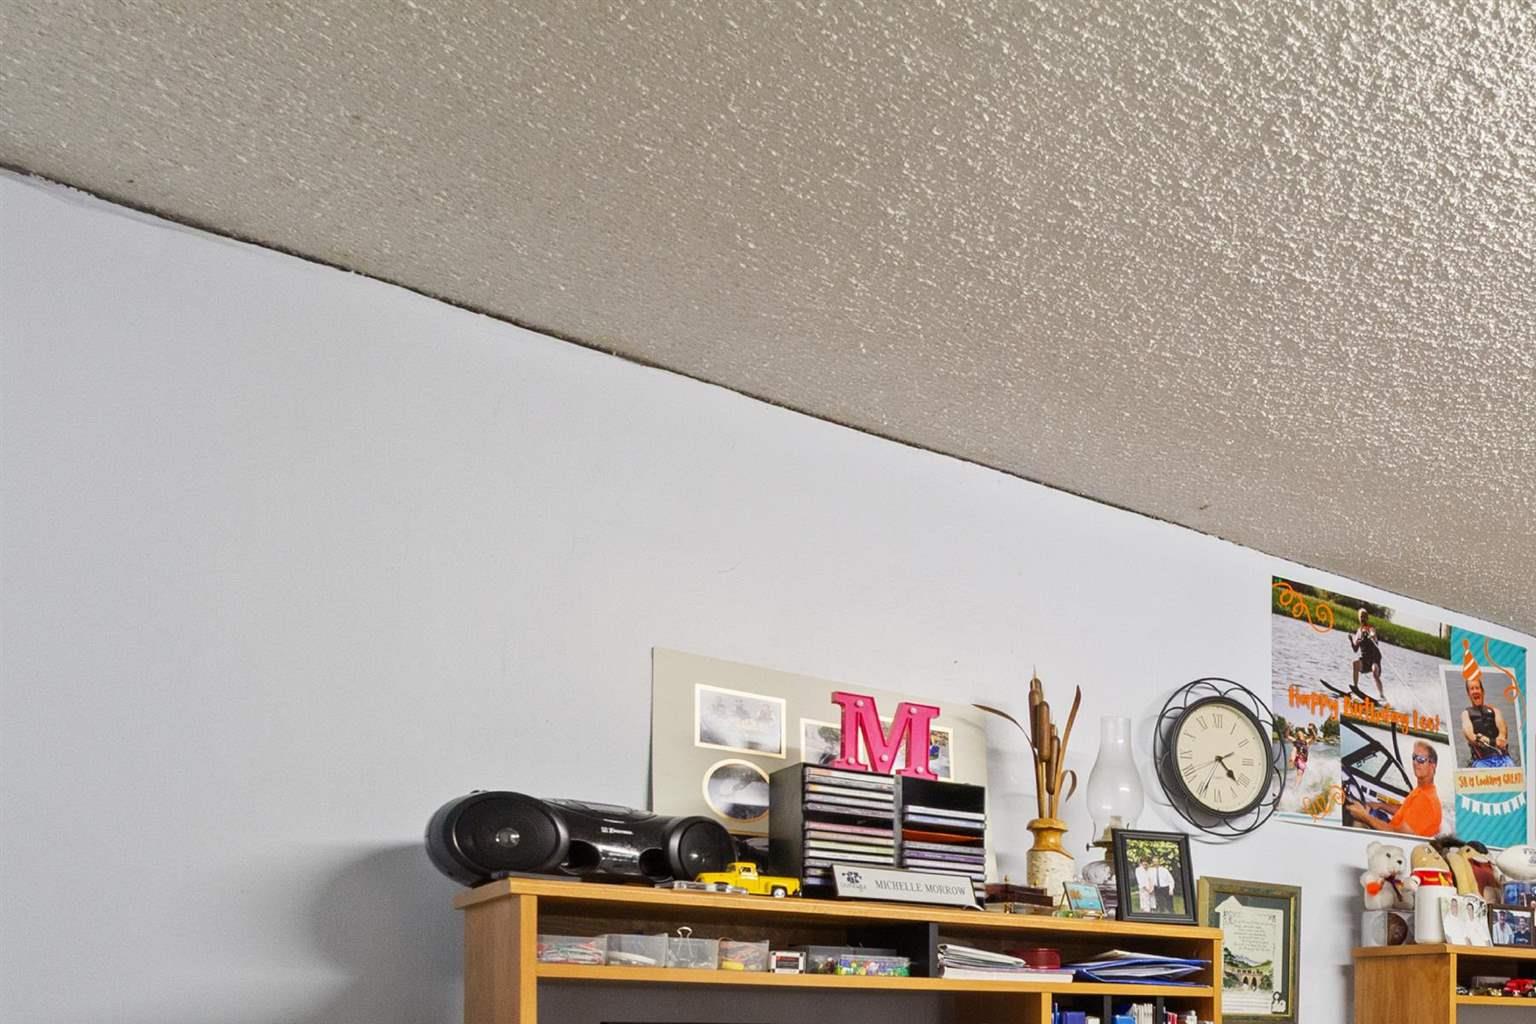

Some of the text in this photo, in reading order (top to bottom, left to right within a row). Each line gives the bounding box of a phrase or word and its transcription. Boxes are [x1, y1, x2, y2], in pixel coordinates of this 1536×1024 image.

[1288, 684, 1339, 720] Happy
[1343, 694, 1409, 735] Birthday
[831, 691, 941, 780] M
[875, 880, 924, 893] MICHELLE
[925, 884, 966, 896] MORROW
